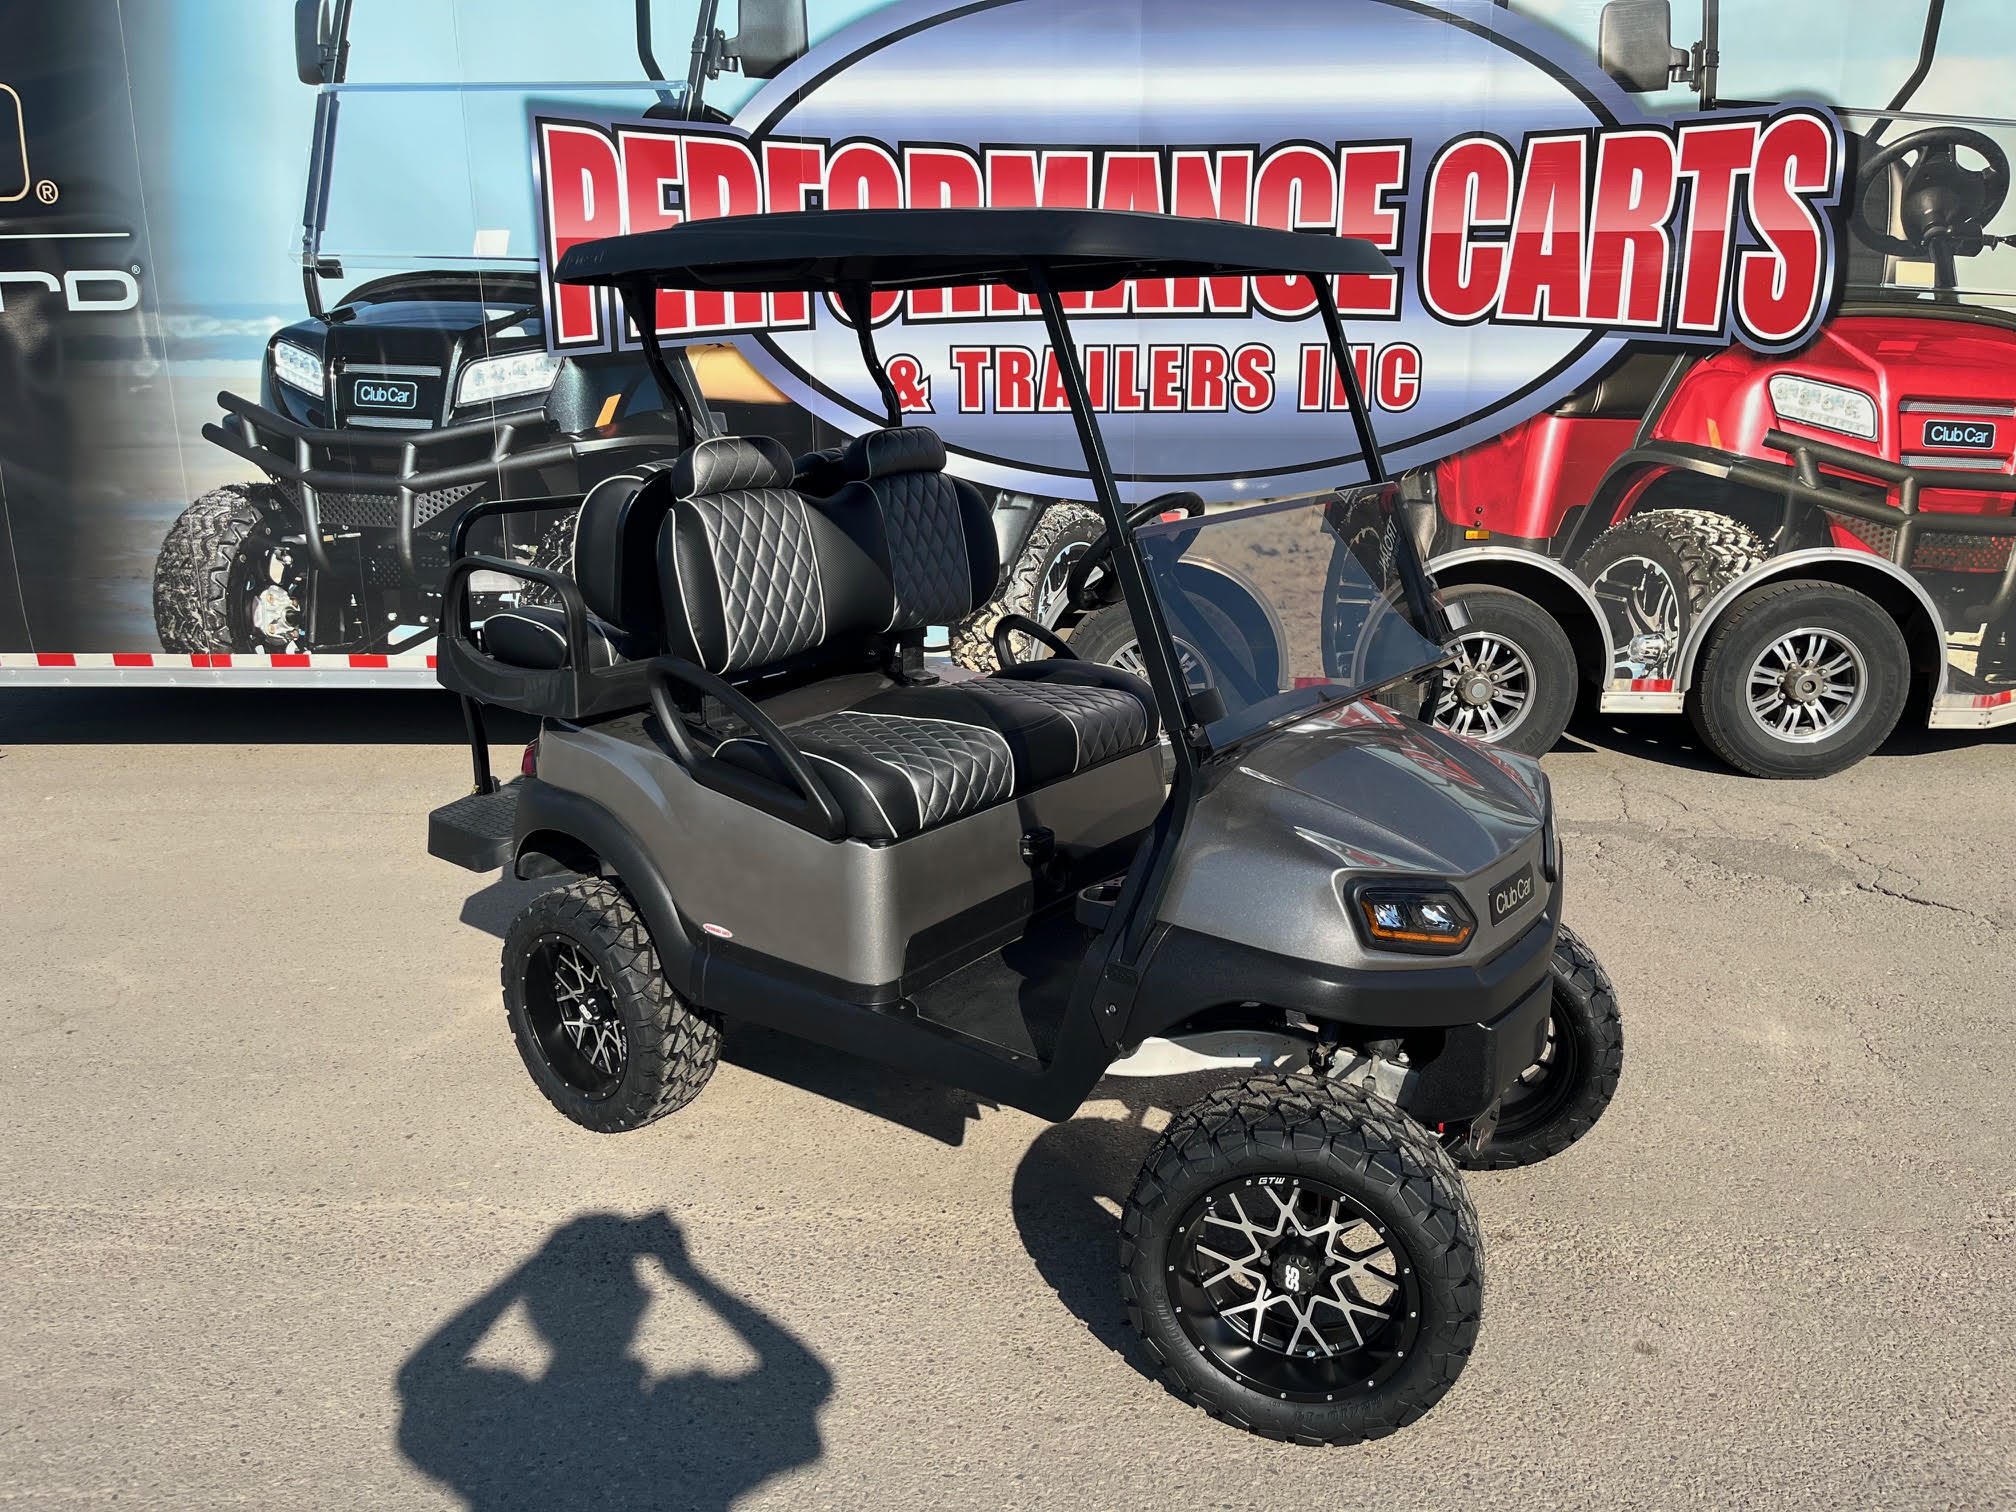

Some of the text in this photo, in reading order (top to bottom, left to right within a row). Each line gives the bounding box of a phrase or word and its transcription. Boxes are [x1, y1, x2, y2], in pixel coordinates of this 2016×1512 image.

[539, 111, 1834, 346] PERFORMANCE CARTS
[951, 343, 1275, 414] TRAILERS
[1297, 342, 1423, 413] INC
[388, 387, 410, 403] Car
[1931, 425, 1989, 443] Club Car
[1496, 876, 1531, 914] Club Car
[1258, 1176, 1286, 1185] GTW
